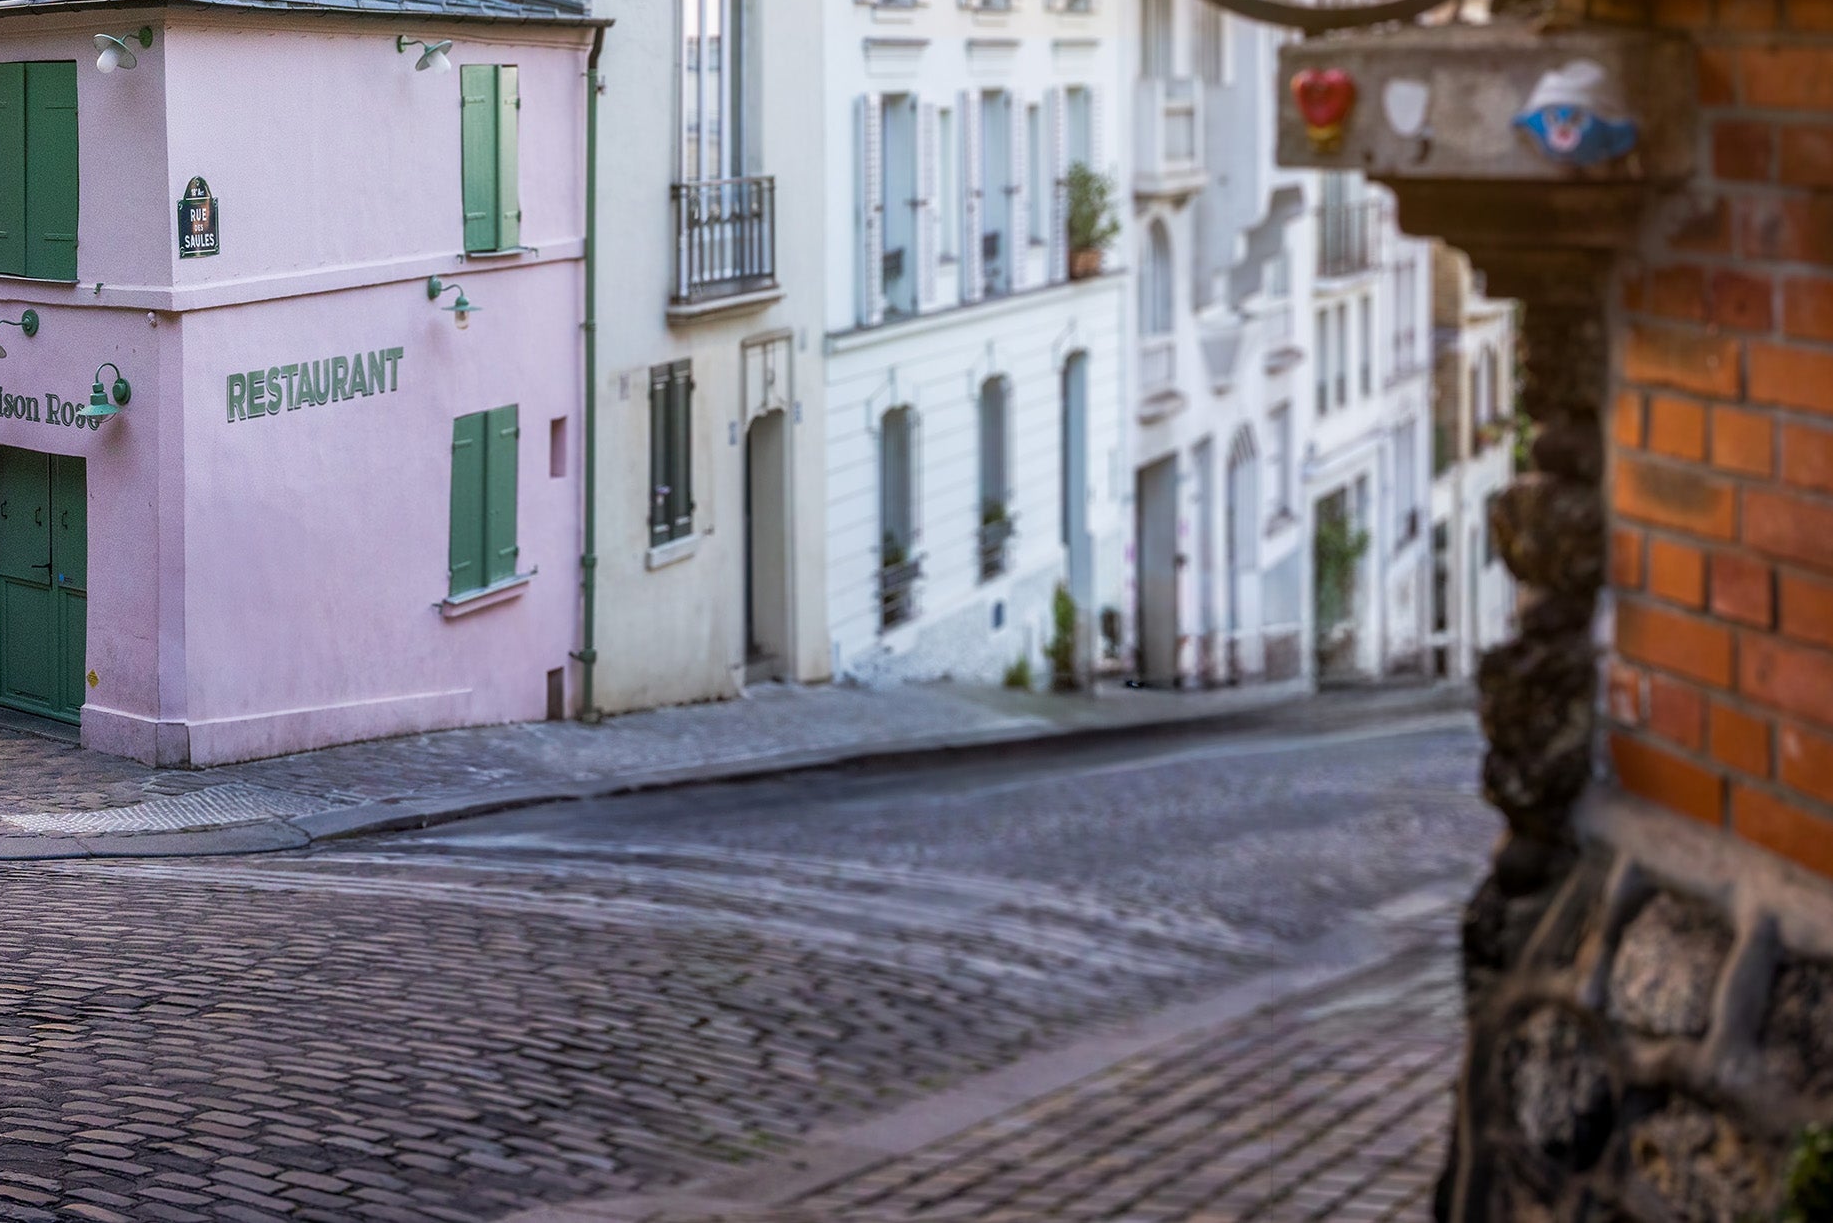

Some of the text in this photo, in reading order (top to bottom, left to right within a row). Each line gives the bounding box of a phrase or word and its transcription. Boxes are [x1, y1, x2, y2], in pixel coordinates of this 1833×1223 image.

[190, 208, 207, 222] RUE
[194, 224, 204, 232] DES
[184, 234, 215, 249] SAULES
[226, 346, 404, 423] RESTAURANT
